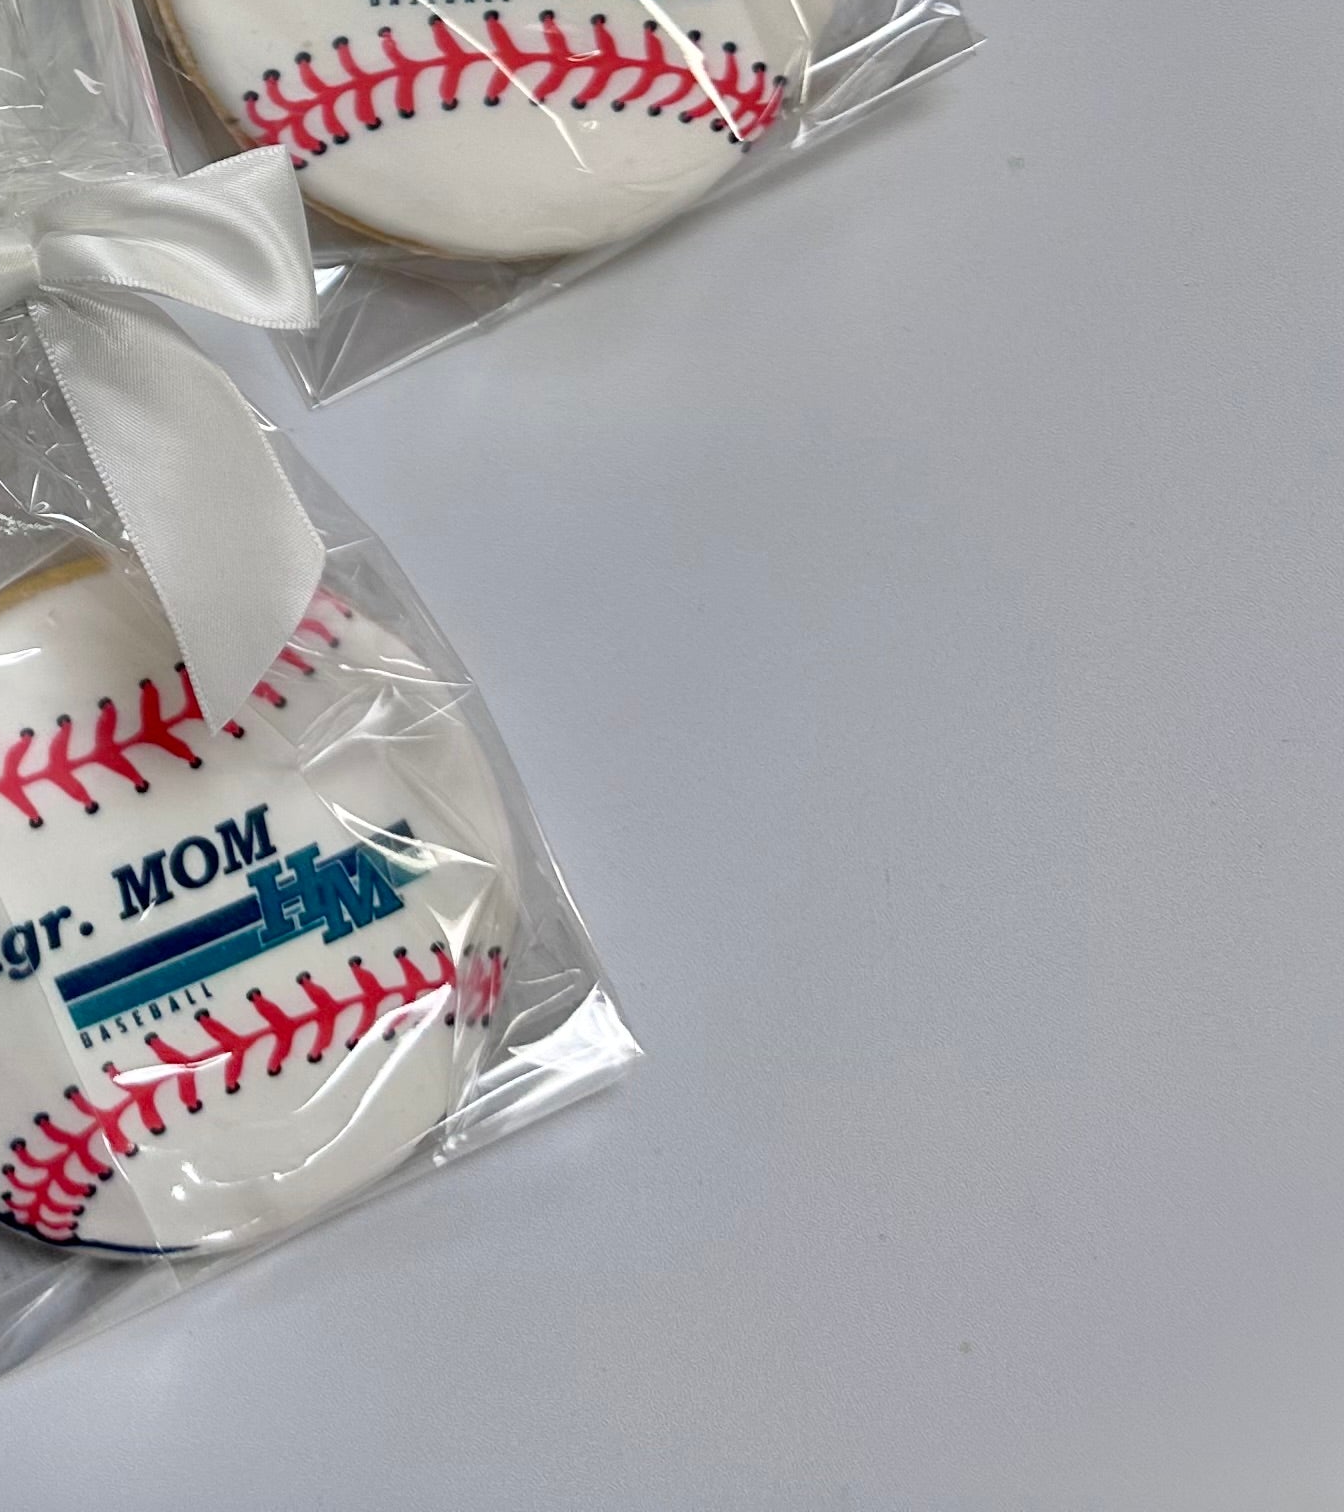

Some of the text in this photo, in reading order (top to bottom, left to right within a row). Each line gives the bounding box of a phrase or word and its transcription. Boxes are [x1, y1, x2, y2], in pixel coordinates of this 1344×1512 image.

[111, 802, 276, 920] MOM
[247, 841, 405, 945] HM
[80, 983, 214, 1049] BASEBALL
